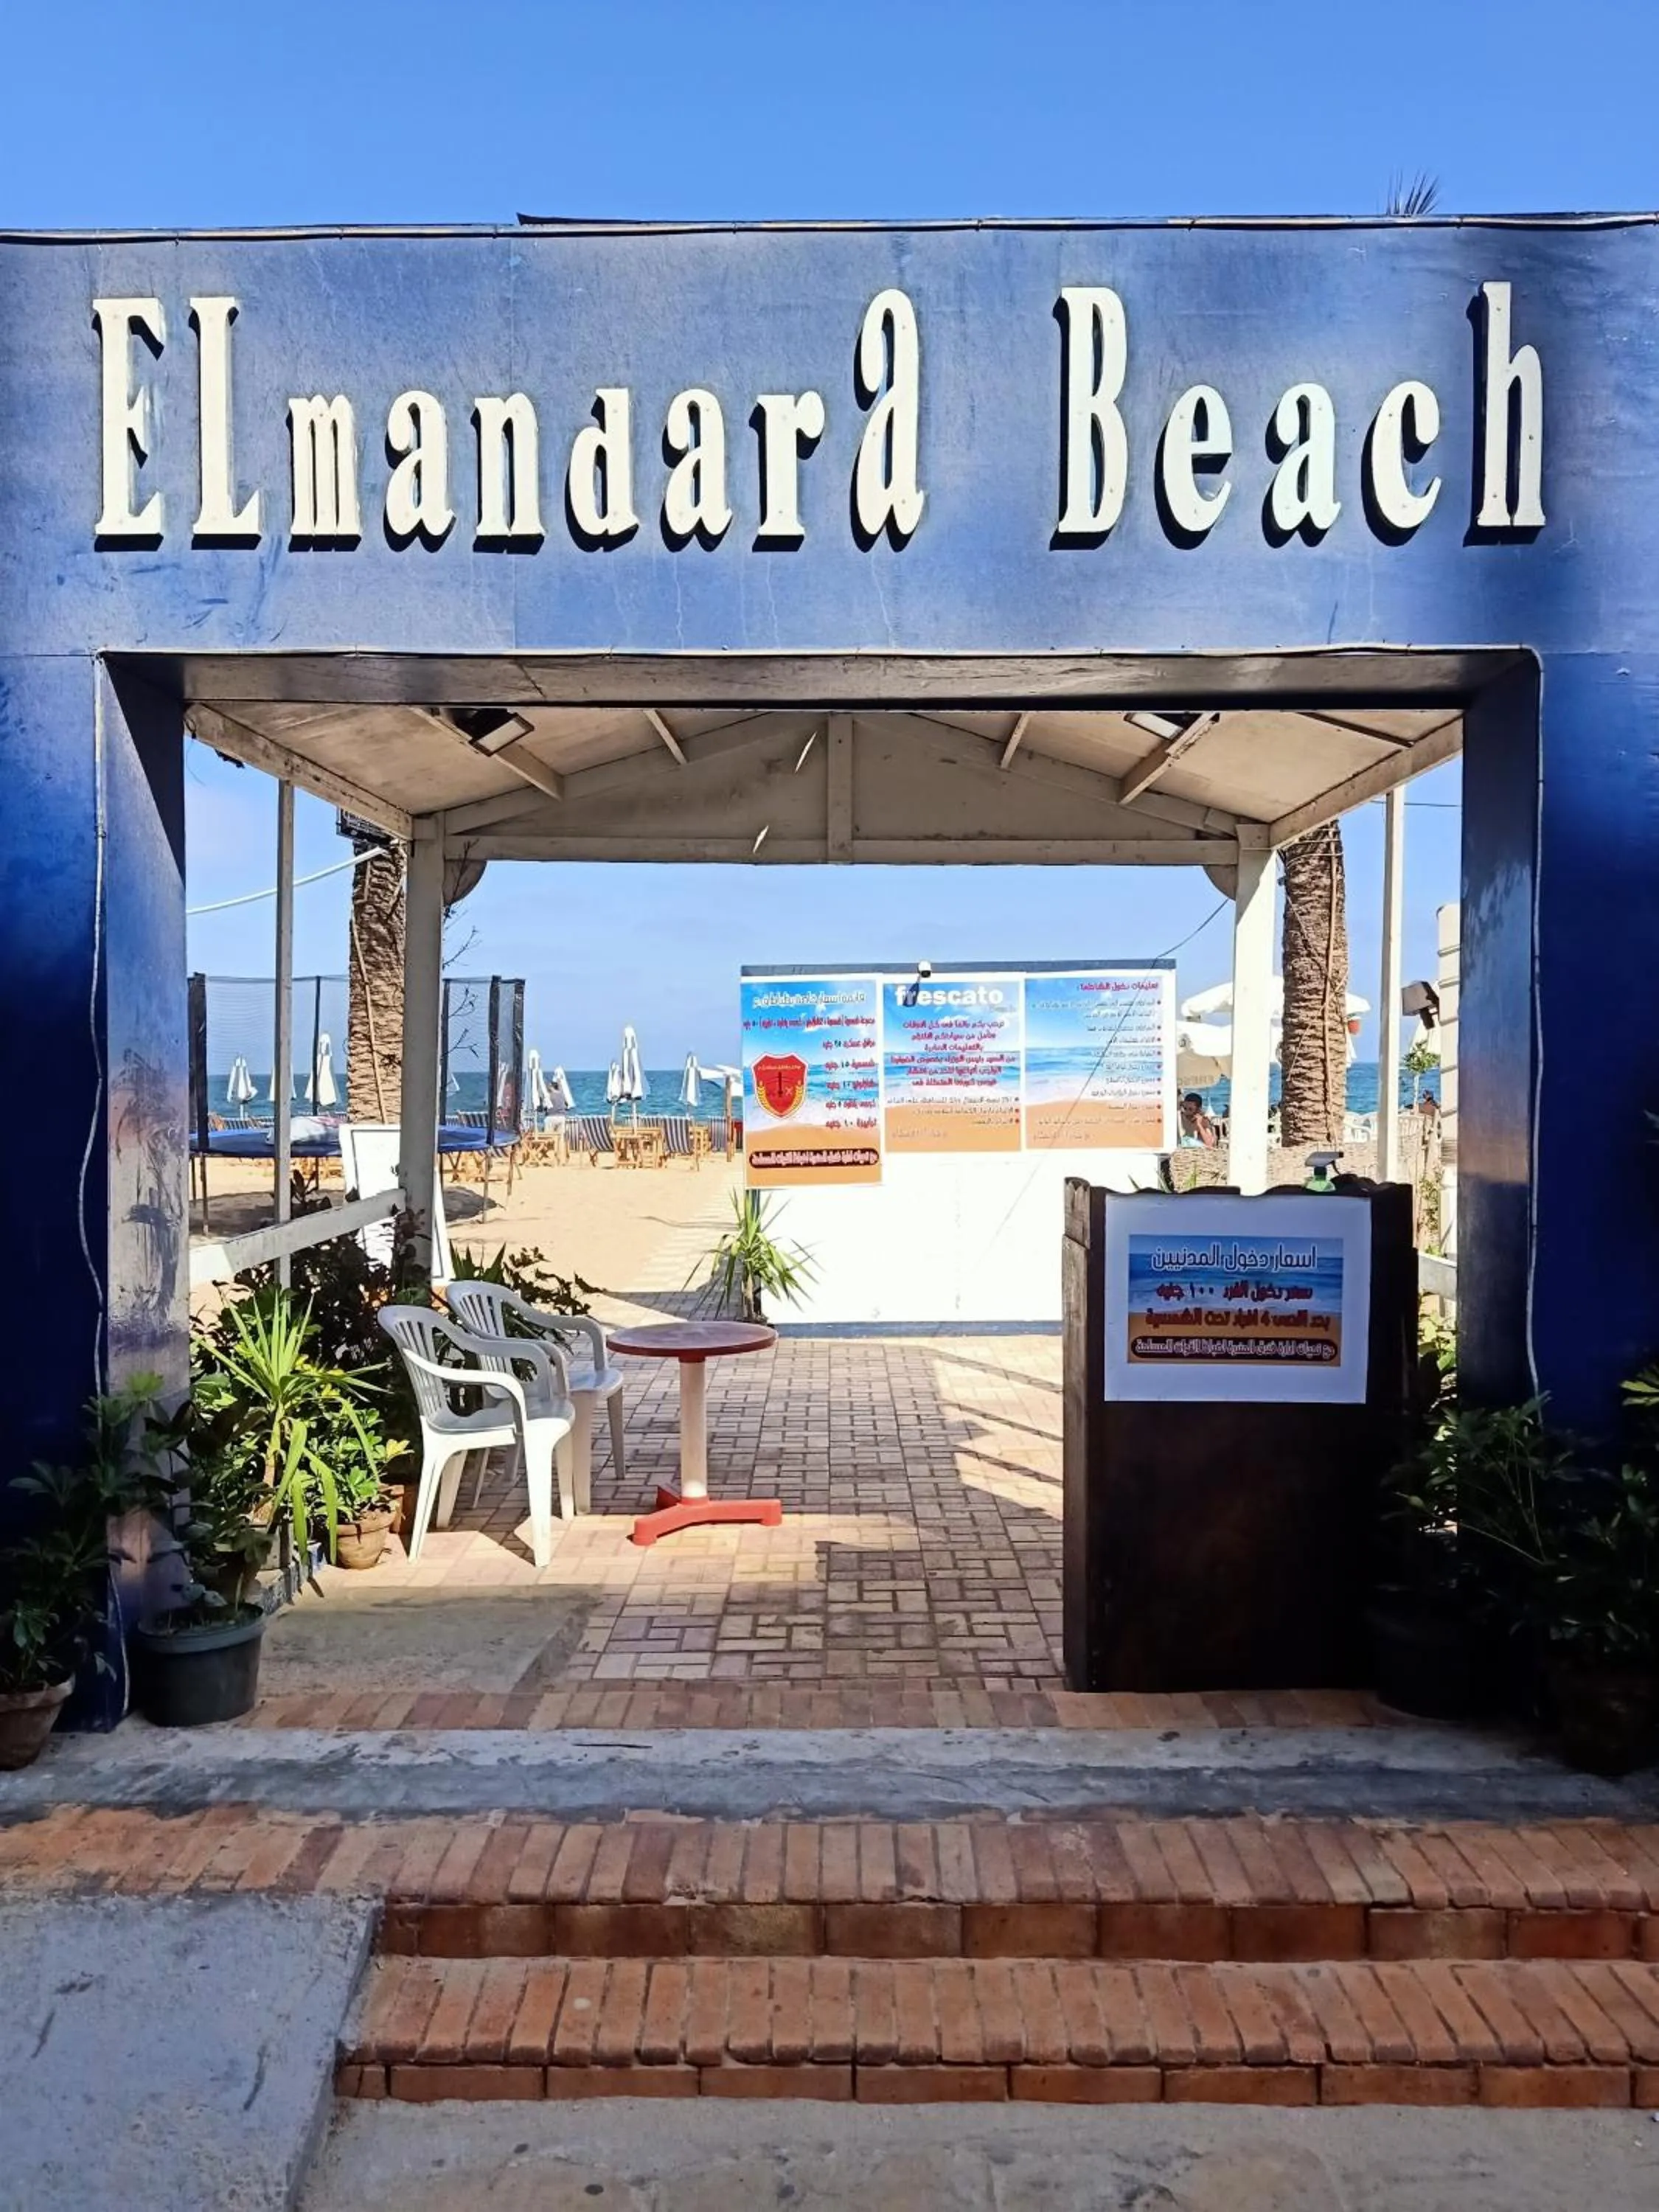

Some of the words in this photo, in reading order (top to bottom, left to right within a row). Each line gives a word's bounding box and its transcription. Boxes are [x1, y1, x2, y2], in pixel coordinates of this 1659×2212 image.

[1053, 281, 1546, 538] Beach
[895, 985, 1004, 1006] frescato
[1151, 1242, 1222, 1272] المدنيين
[1224, 1242, 1270, 1273] دخول
[1272, 1243, 1318, 1273] اسعار
[1251, 1281, 1283, 1302] دخول
